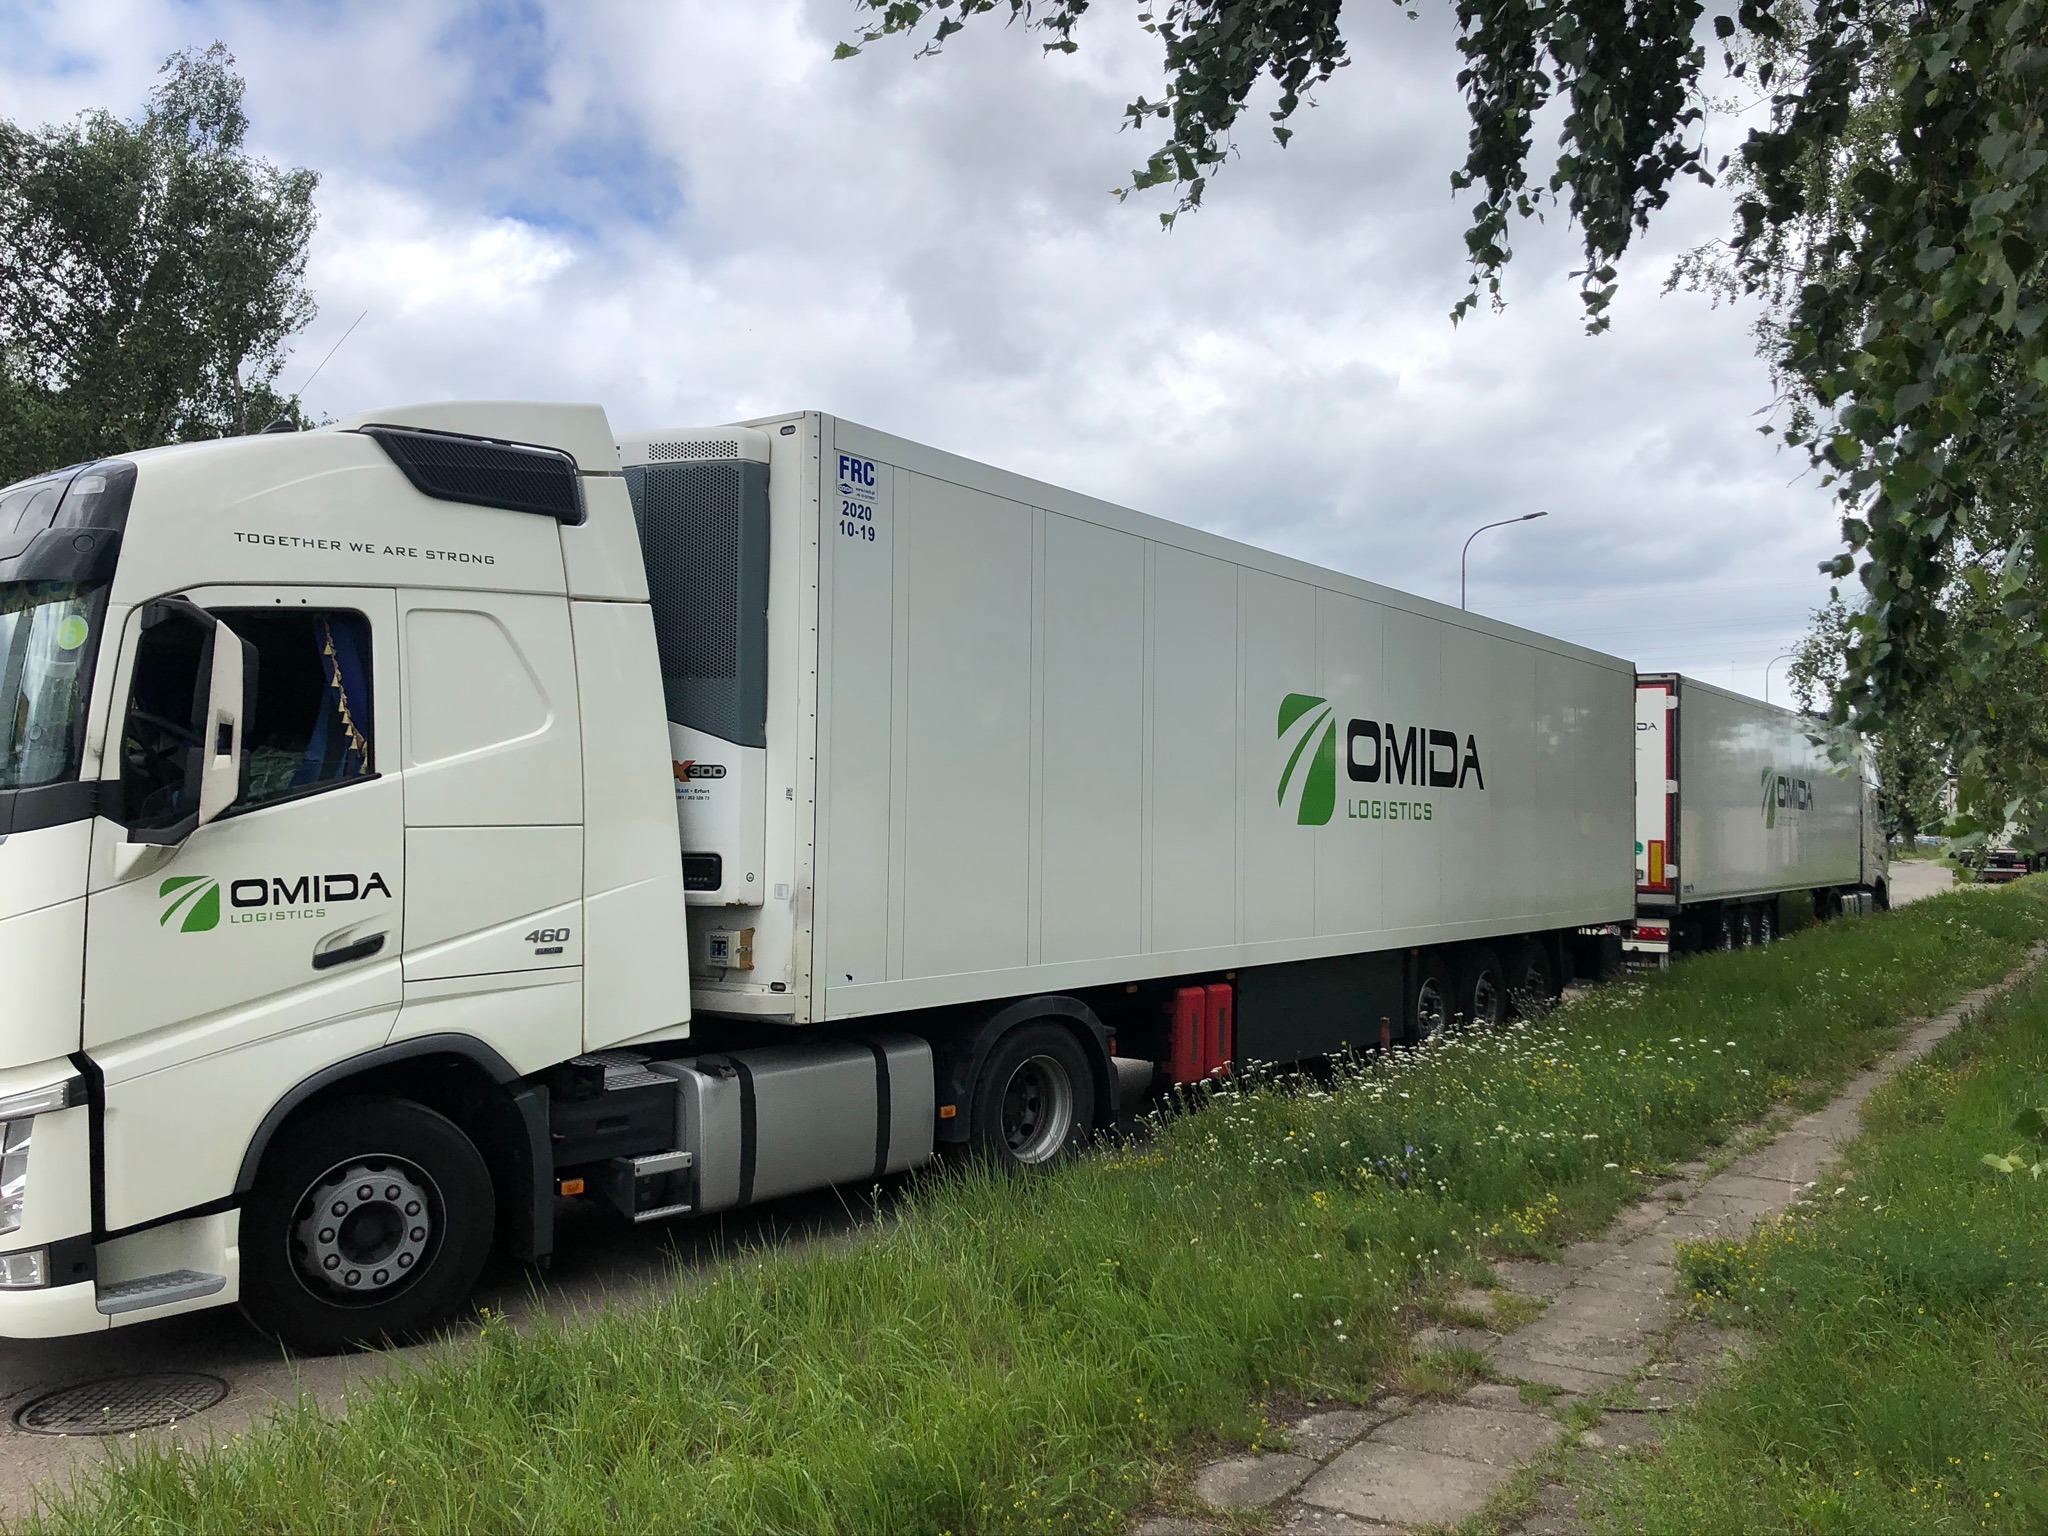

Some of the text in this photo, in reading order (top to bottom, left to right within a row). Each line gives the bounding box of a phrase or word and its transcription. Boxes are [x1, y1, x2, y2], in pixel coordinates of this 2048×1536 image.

[839, 455, 875, 486] FRC
[842, 500, 872, 521] 2020
[839, 519, 875, 541] 10-19
[234, 532, 495, 565] TOGETHER WE ARE STRONG
[1347, 718, 1485, 790] OMIDA
[1777, 776, 1813, 811] OMIDA
[1348, 799, 1432, 820] LOGISTICS
[231, 872, 392, 908] OMIDA
[231, 908, 326, 924] LOGISTICS
[525, 928, 570, 943] 460
